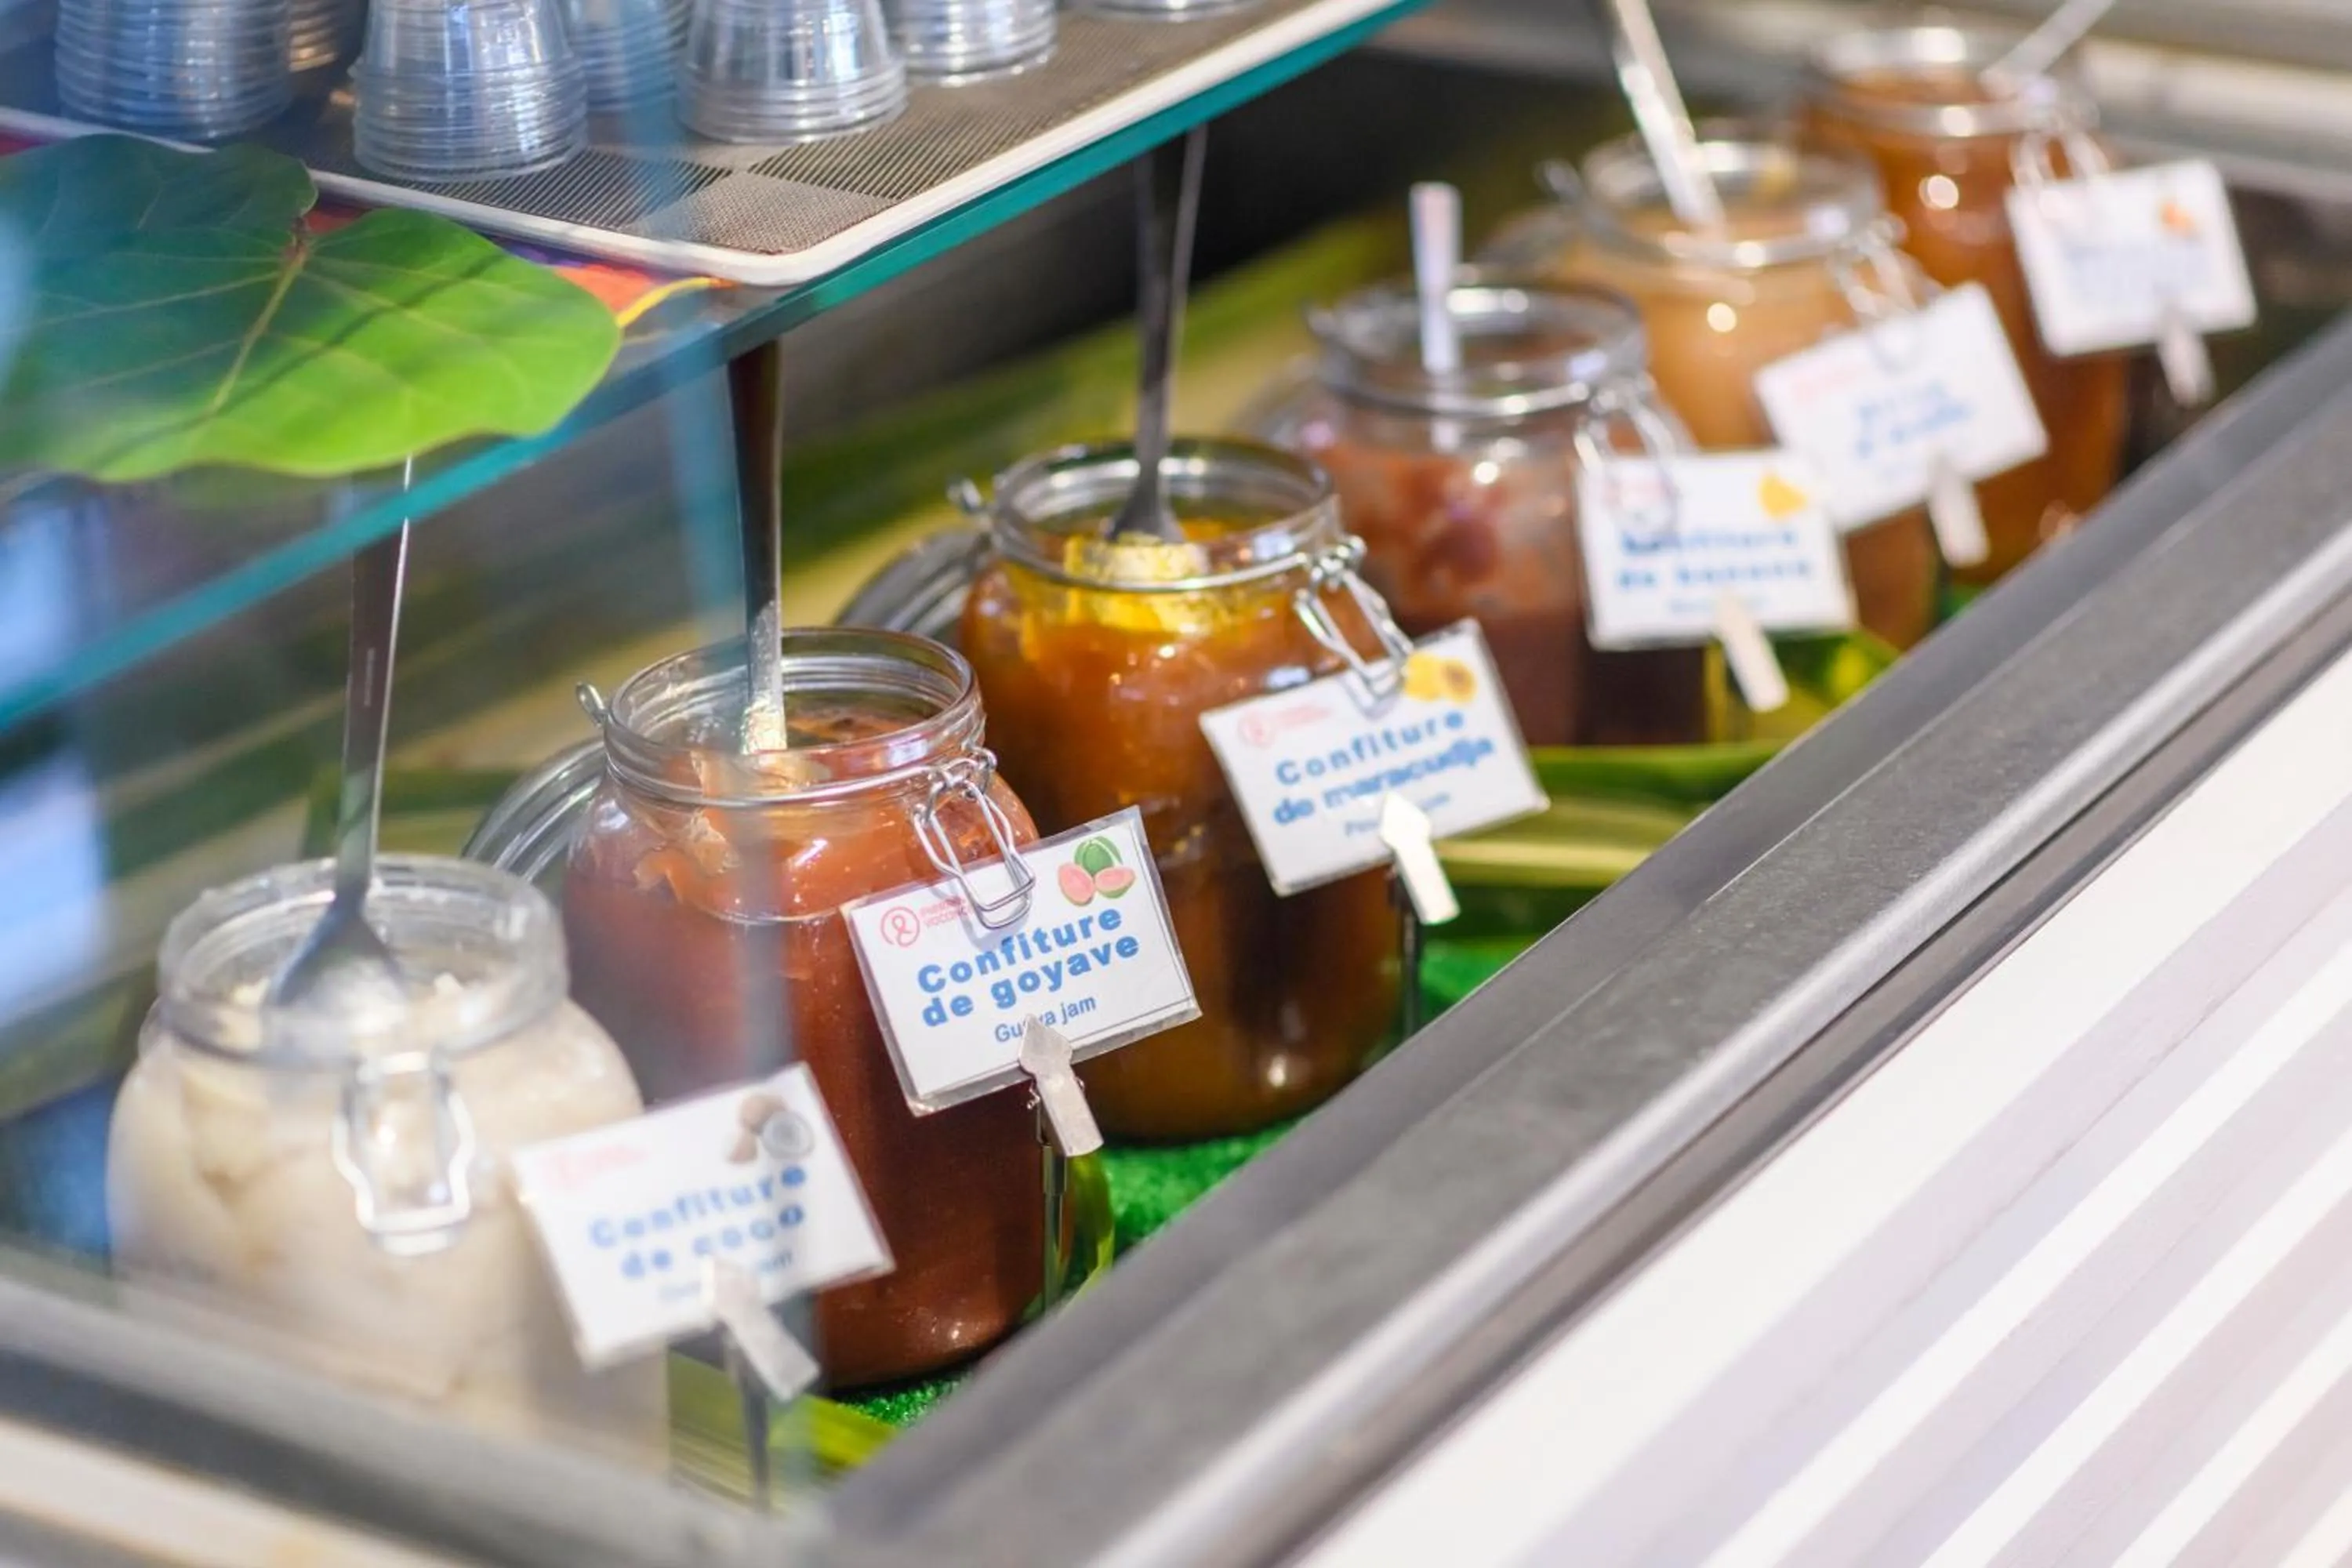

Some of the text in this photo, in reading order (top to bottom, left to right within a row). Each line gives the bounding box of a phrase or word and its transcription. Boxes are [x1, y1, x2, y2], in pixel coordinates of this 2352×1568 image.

[1275, 710, 1465, 786] Confiture
[1272, 797, 1316, 826] de
[916, 907, 1123, 994] Confiture
[921, 935, 1140, 1028] de goyave
[994, 996, 1097, 1044] Gua jam
[588, 1164, 808, 1248] Confiture
[620, 1249, 673, 1279] de
